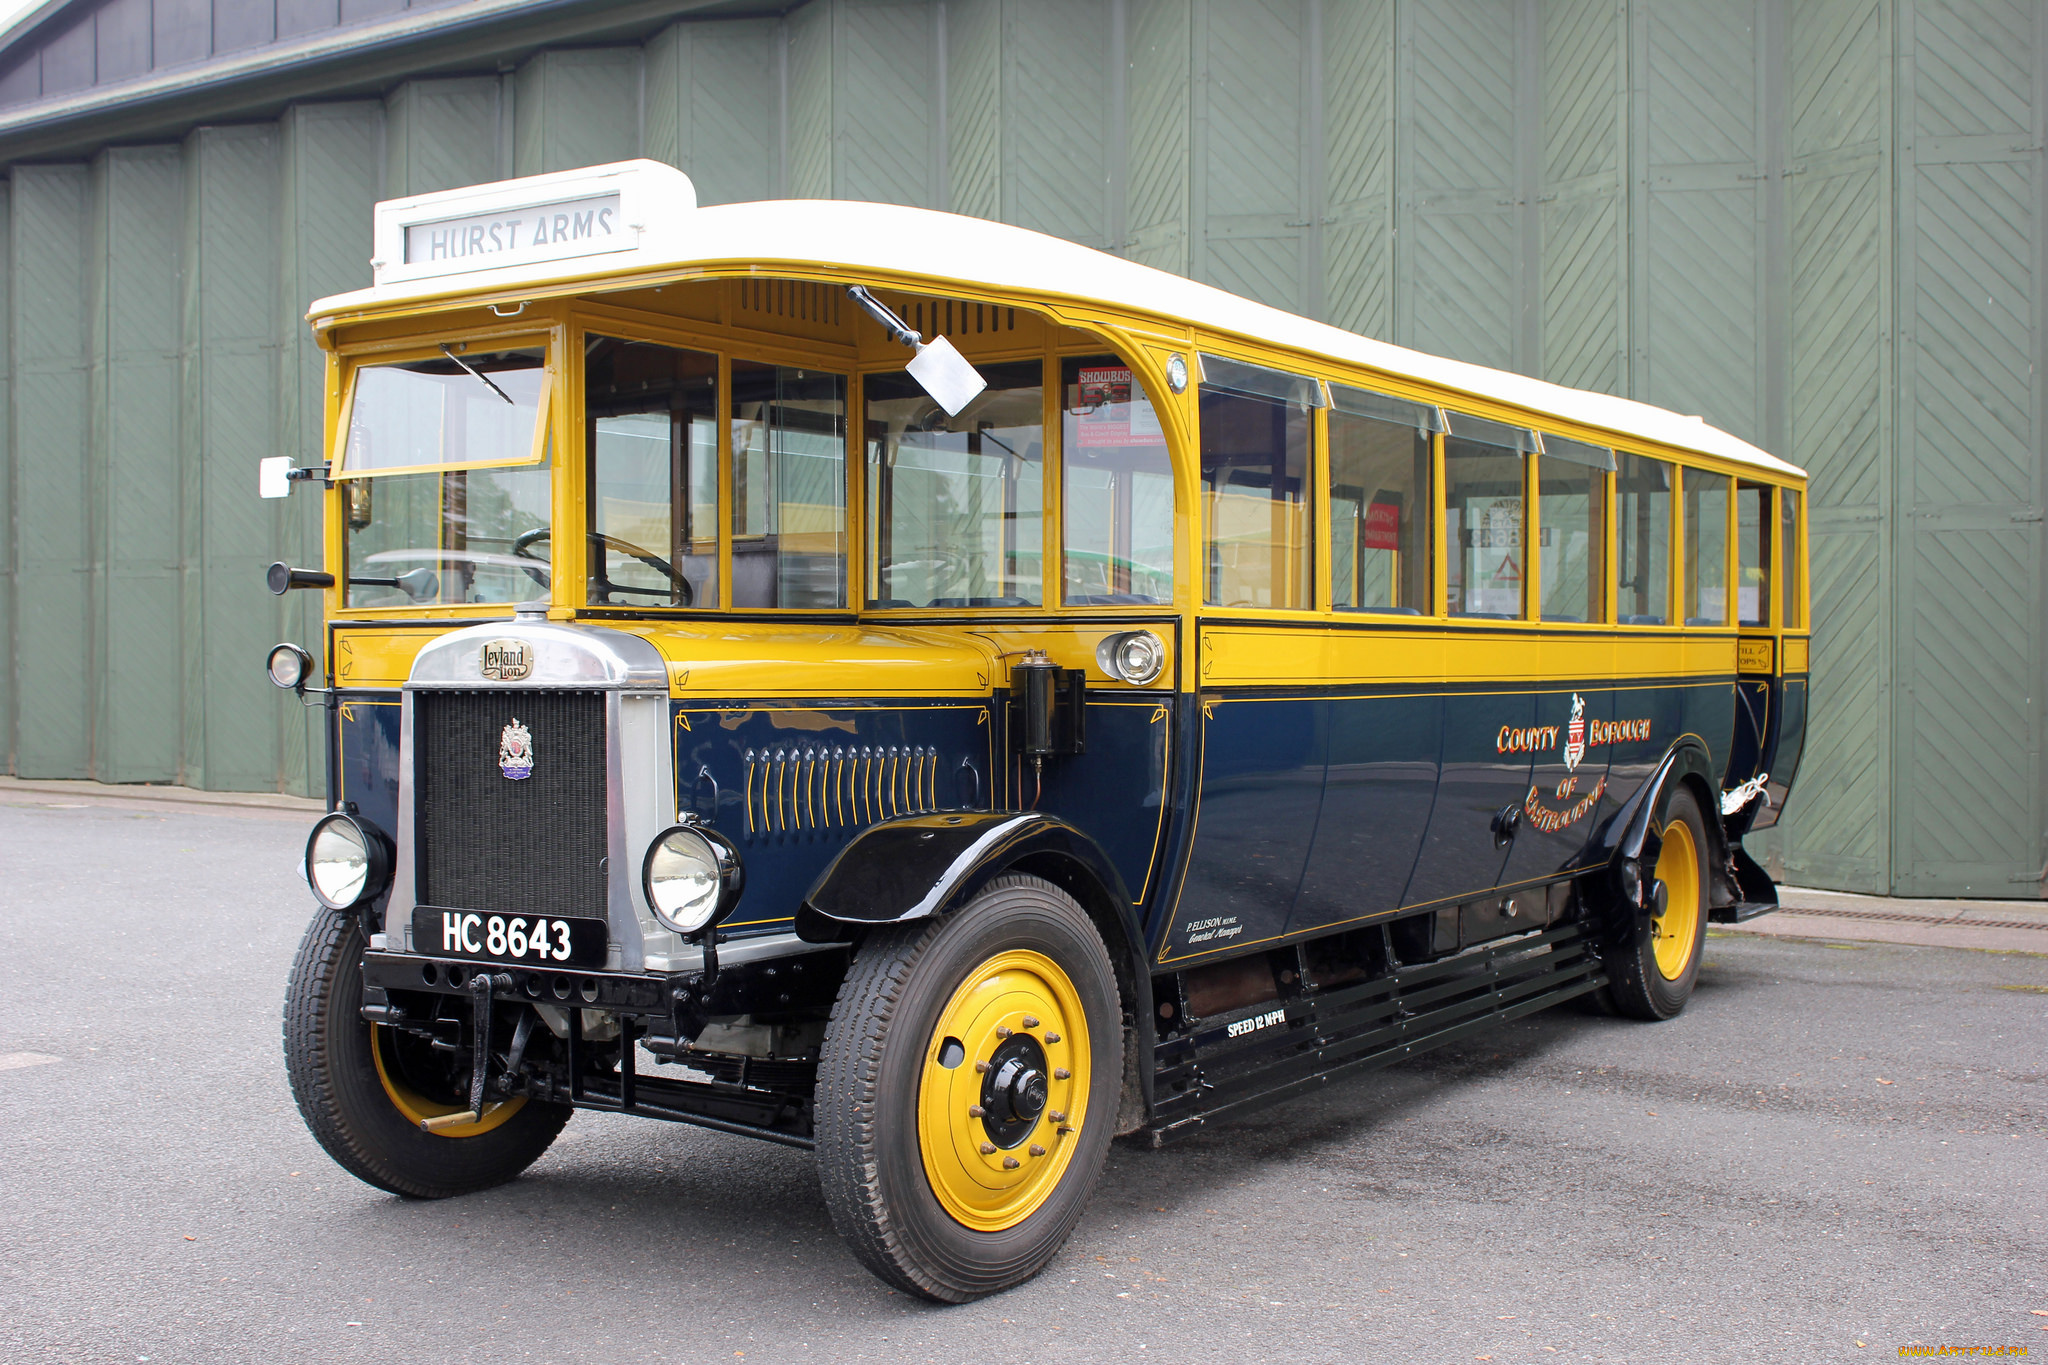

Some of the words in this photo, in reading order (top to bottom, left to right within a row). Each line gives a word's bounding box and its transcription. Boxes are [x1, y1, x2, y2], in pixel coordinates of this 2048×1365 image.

[431, 219, 521, 261] HURST
[533, 207, 613, 246] ARMS
[1080, 370, 1131, 383] SHOWBUS
[484, 645, 524, 670] Leyland
[499, 664, 527, 679] Lion
[1497, 725, 1560, 753] COUNTY
[1589, 719, 1651, 746] BOROUGH
[1556, 776, 1578, 799] OF
[442, 912, 482, 953] HC
[486, 915, 572, 961] 8643
[1228, 1018, 1255, 1037] SPEED
[1254, 1015, 1265, 1030] 12
